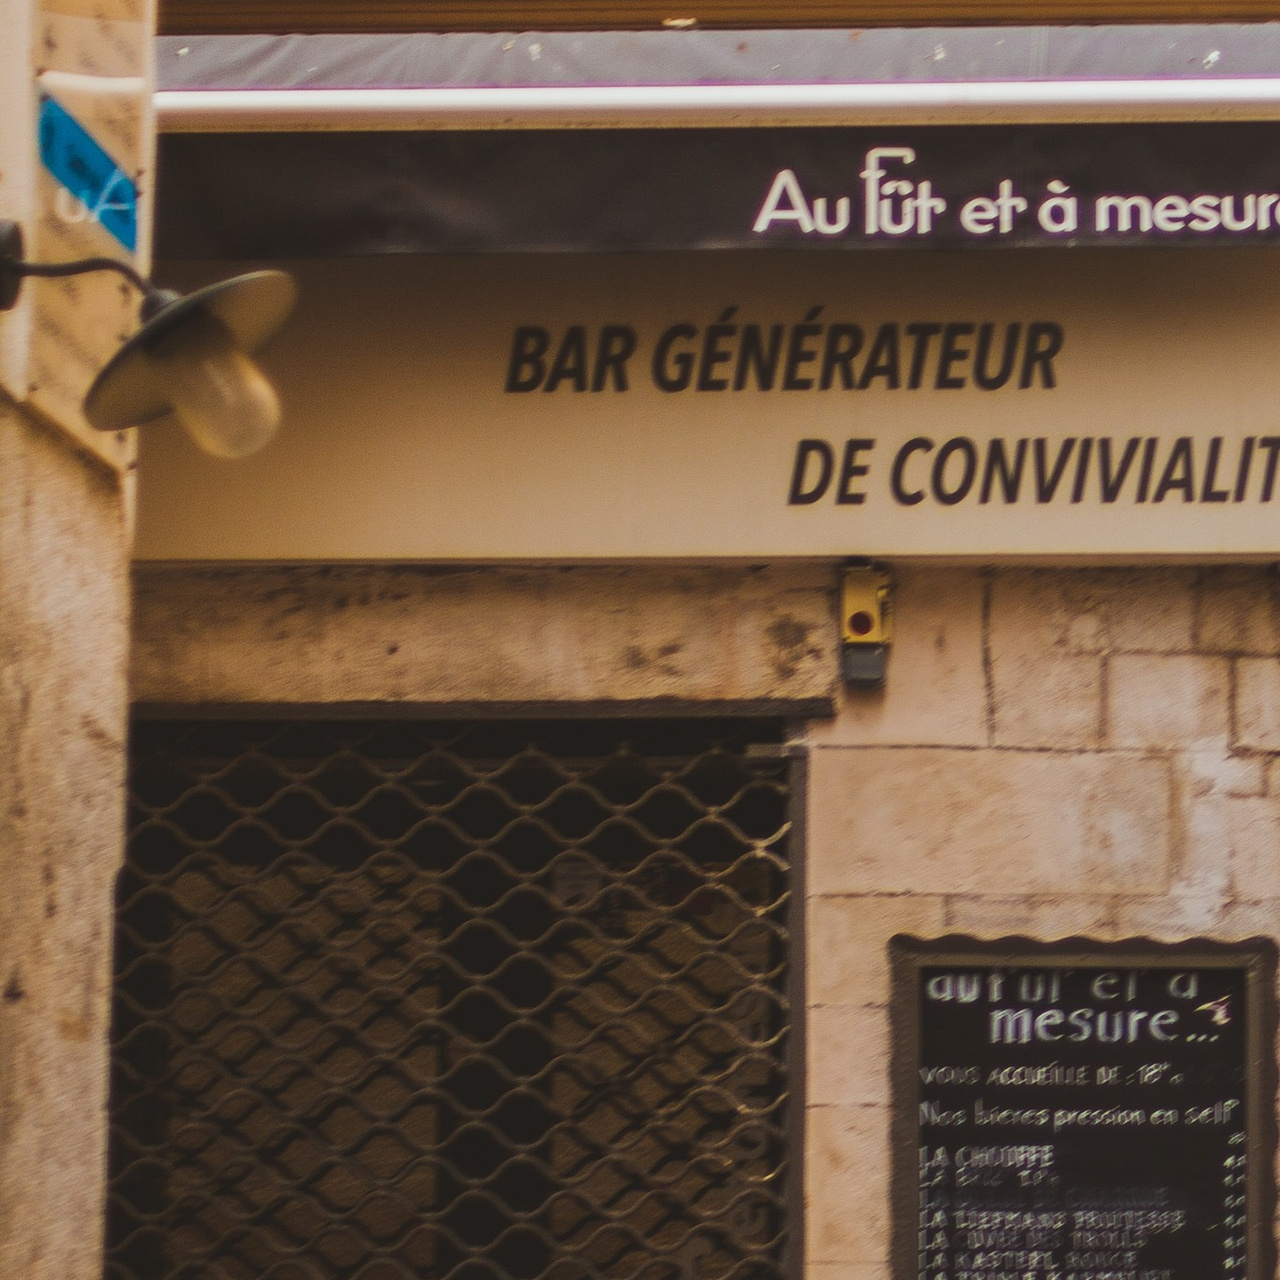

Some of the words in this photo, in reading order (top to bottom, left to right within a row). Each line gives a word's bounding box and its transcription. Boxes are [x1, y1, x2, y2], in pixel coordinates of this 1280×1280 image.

[753, 169, 849, 234] Au
[862, 147, 946, 236] fût
[962, 178, 1030, 234] et
[1039, 178, 1079, 234] à
[505, 322, 636, 395] BAR
[652, 306, 1064, 394] GÉNÉRATEUR
[788, 437, 875, 507] DE
